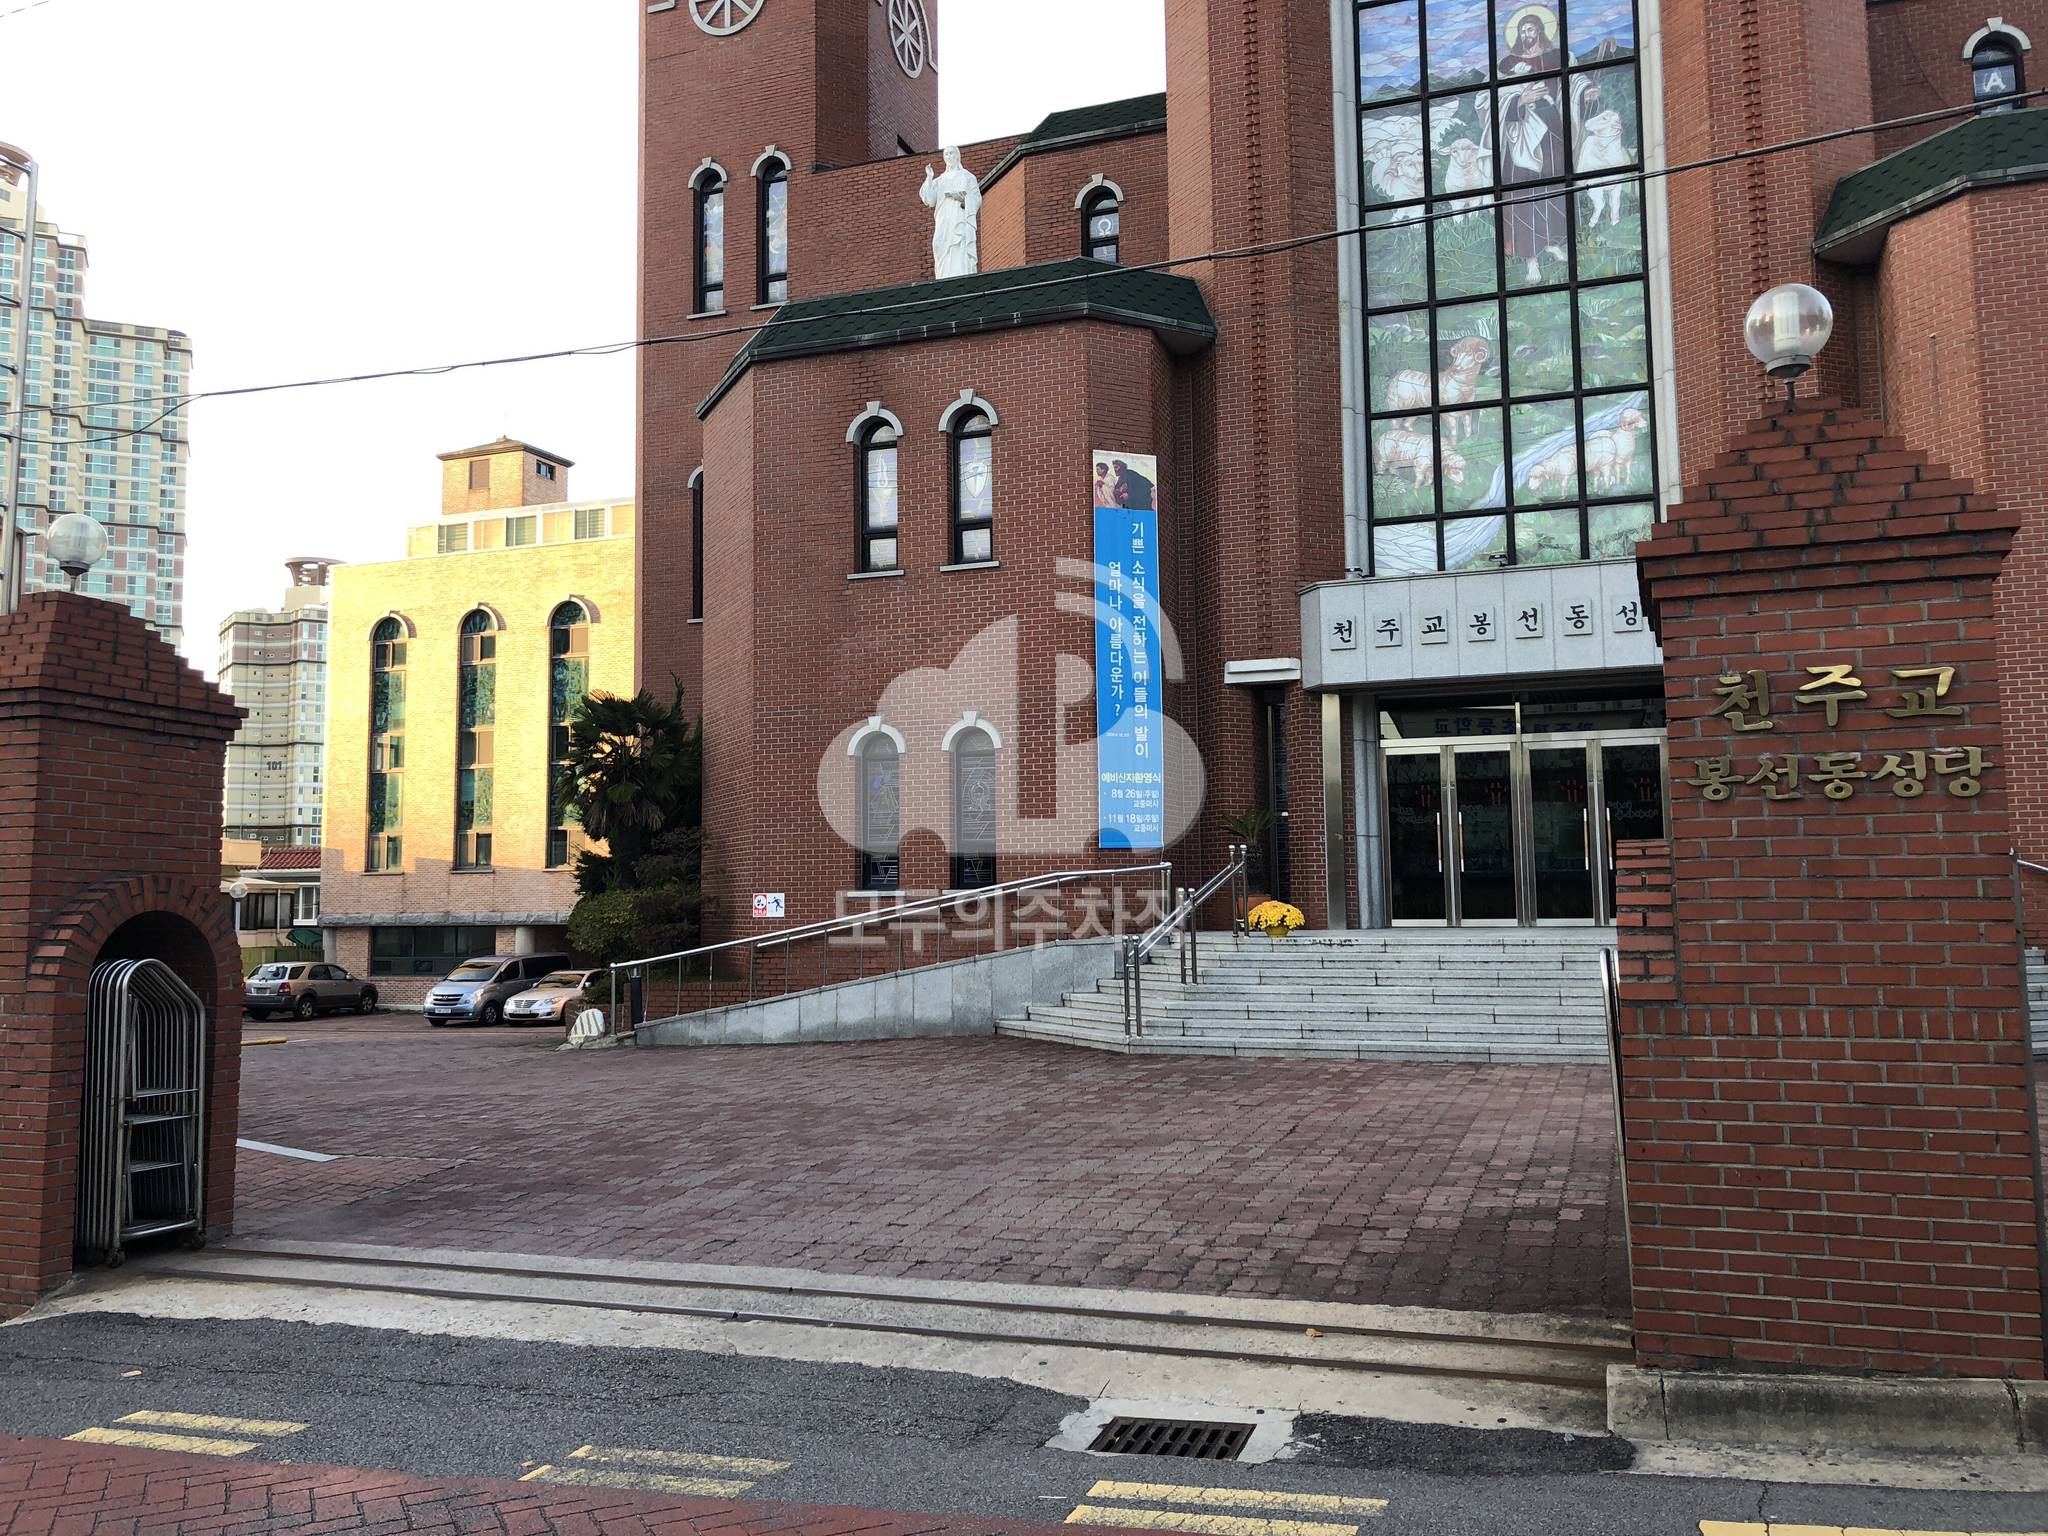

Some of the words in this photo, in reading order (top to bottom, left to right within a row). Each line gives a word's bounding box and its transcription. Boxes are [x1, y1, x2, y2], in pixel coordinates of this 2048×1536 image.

[1131, 521, 1145, 554] 기쁜
[1108, 561, 1123, 611] 얼마나
[1132, 560, 1146, 609] 소식을
[1133, 615, 1147, 664] 전하는
[1133, 670, 1148, 720] 이들의
[1711, 664, 1963, 732] 천주교
[266, 761, 282, 771] 101
[1134, 725, 1150, 759] 발이
[1687, 746, 1994, 801] 봉선동성당
